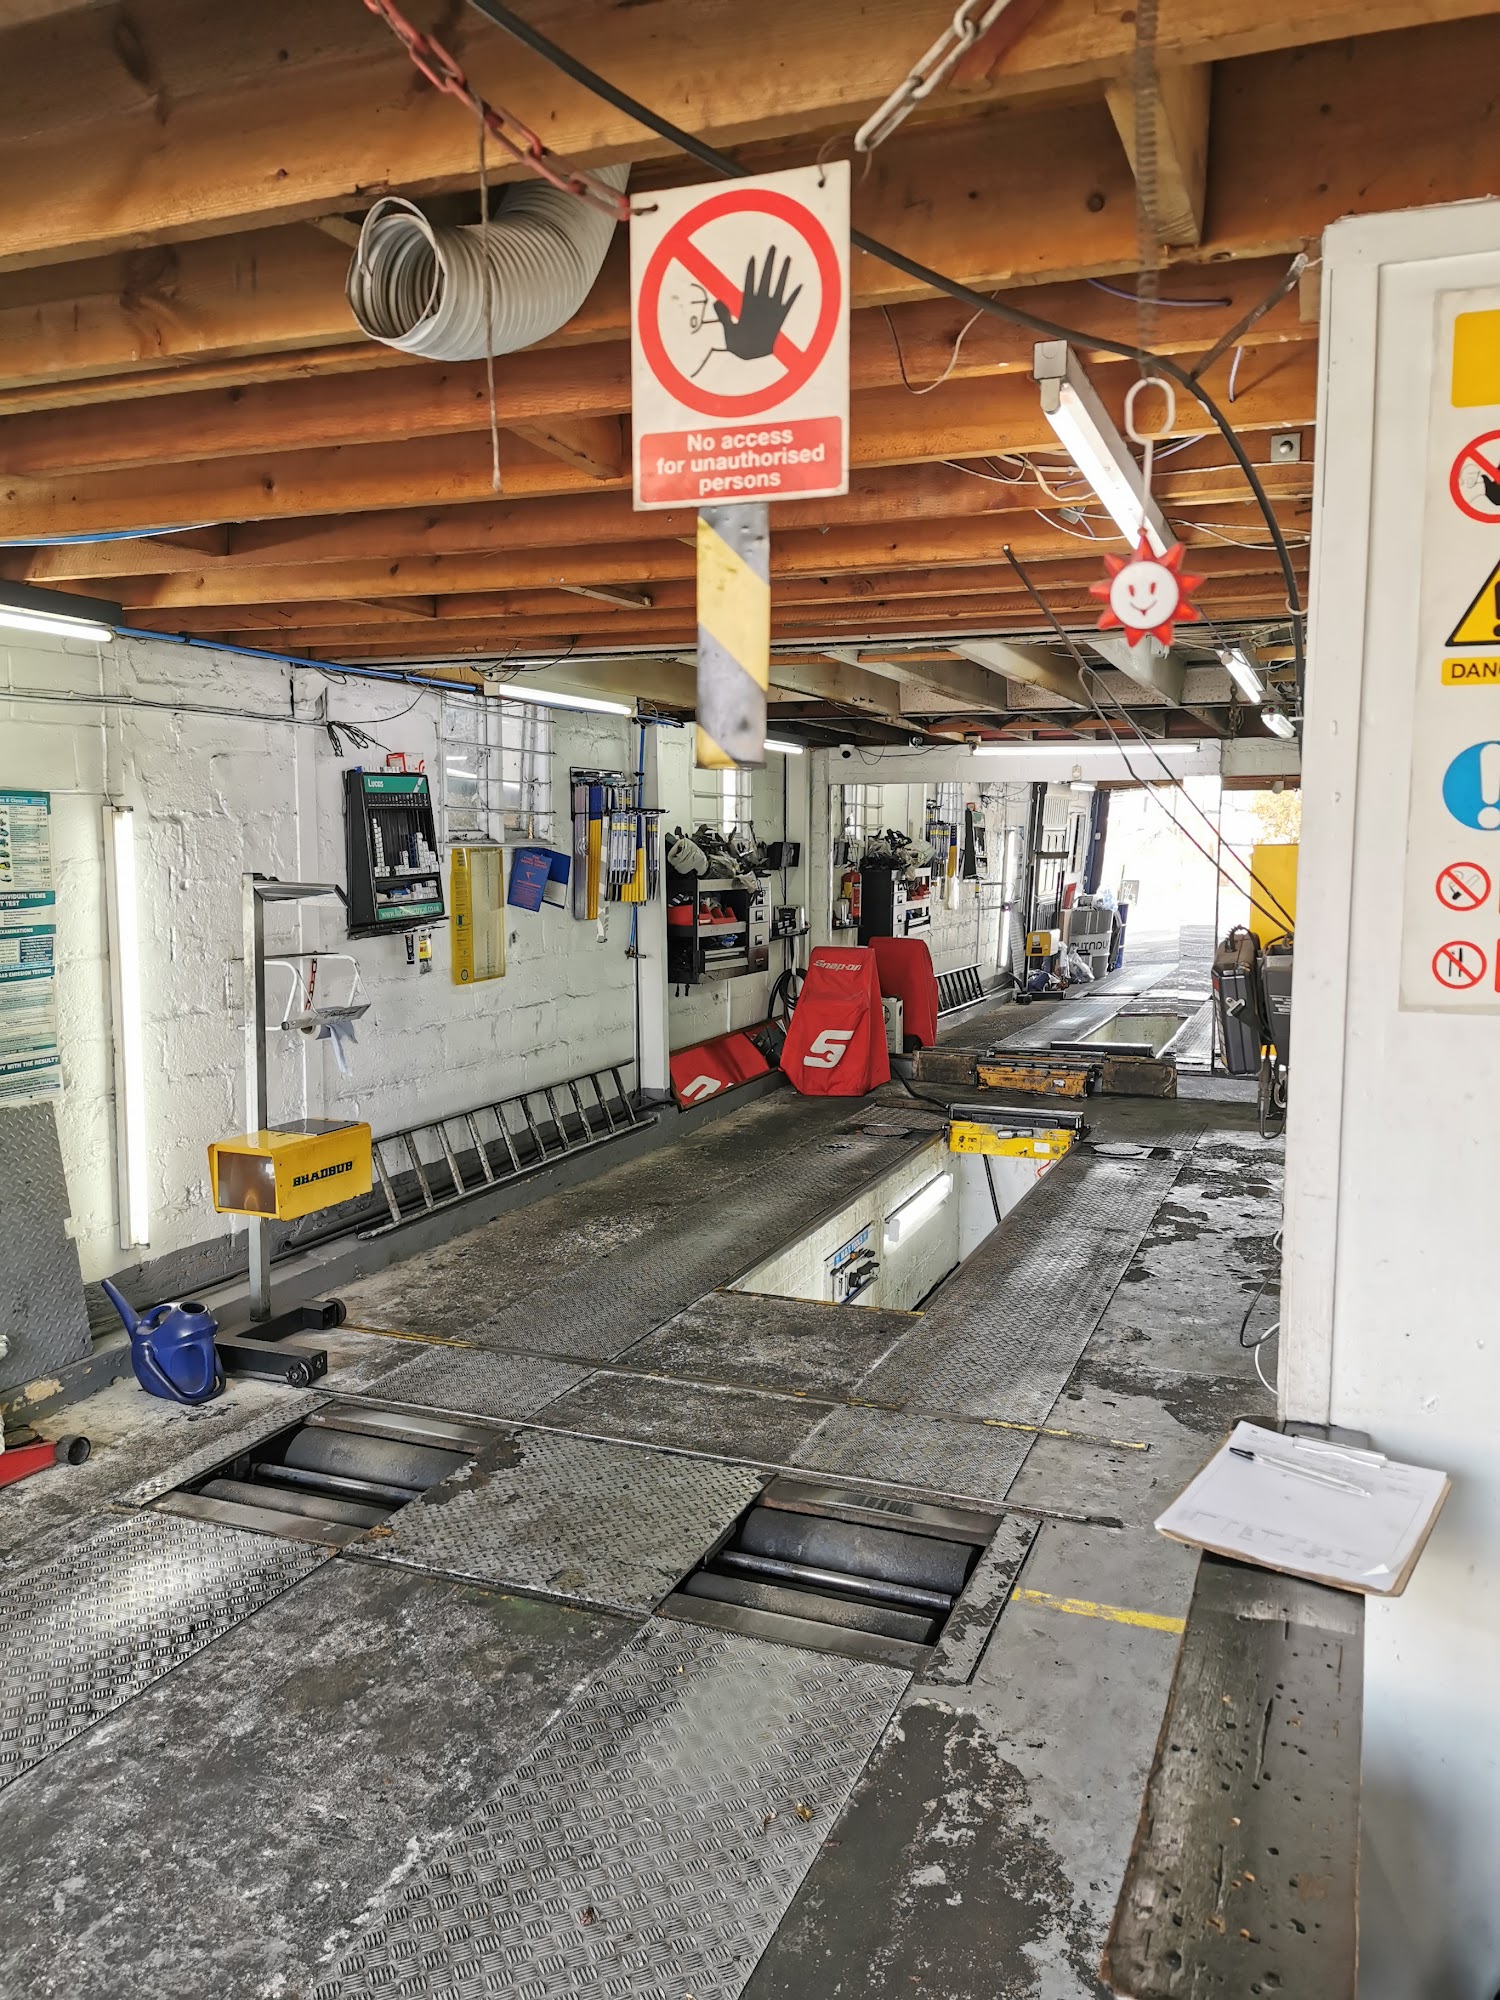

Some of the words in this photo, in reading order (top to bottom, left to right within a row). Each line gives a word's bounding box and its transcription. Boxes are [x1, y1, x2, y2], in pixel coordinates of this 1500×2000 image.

[687, 434, 715, 452] No
[721, 429, 793, 450] access
[656, 457, 684, 475] for
[690, 443, 825, 473] unauthorised
[698, 472, 781, 496] persons
[1451, 662, 1500, 678] DAN
[813, 960, 862, 971] Snap-on
[34, 1057, 58, 1065] RESULT?
